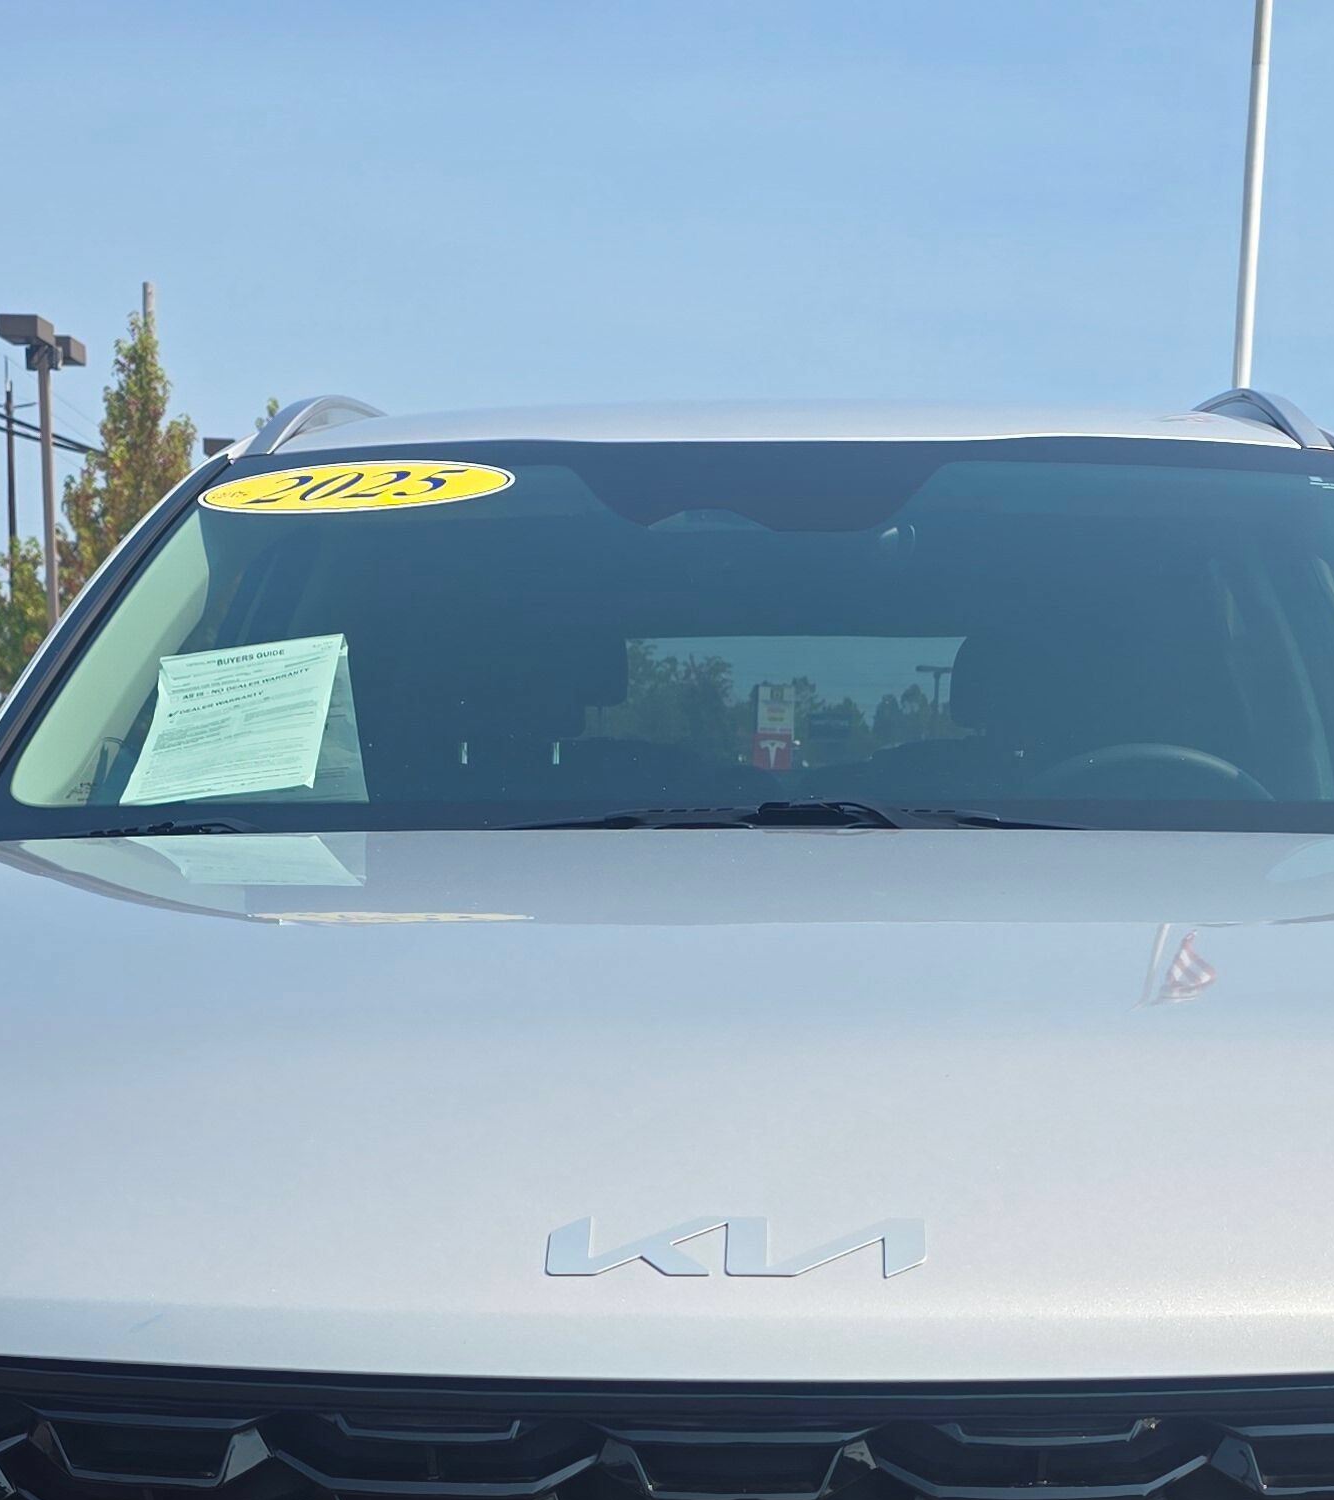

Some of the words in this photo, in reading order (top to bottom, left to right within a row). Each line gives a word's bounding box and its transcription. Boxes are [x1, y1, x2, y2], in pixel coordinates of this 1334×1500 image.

[244, 470, 468, 505] 2025
[216, 653, 254, 667] BUYERS
[256, 649, 286, 659] GUIDE
[262, 667, 310, 684] WARRANTY
